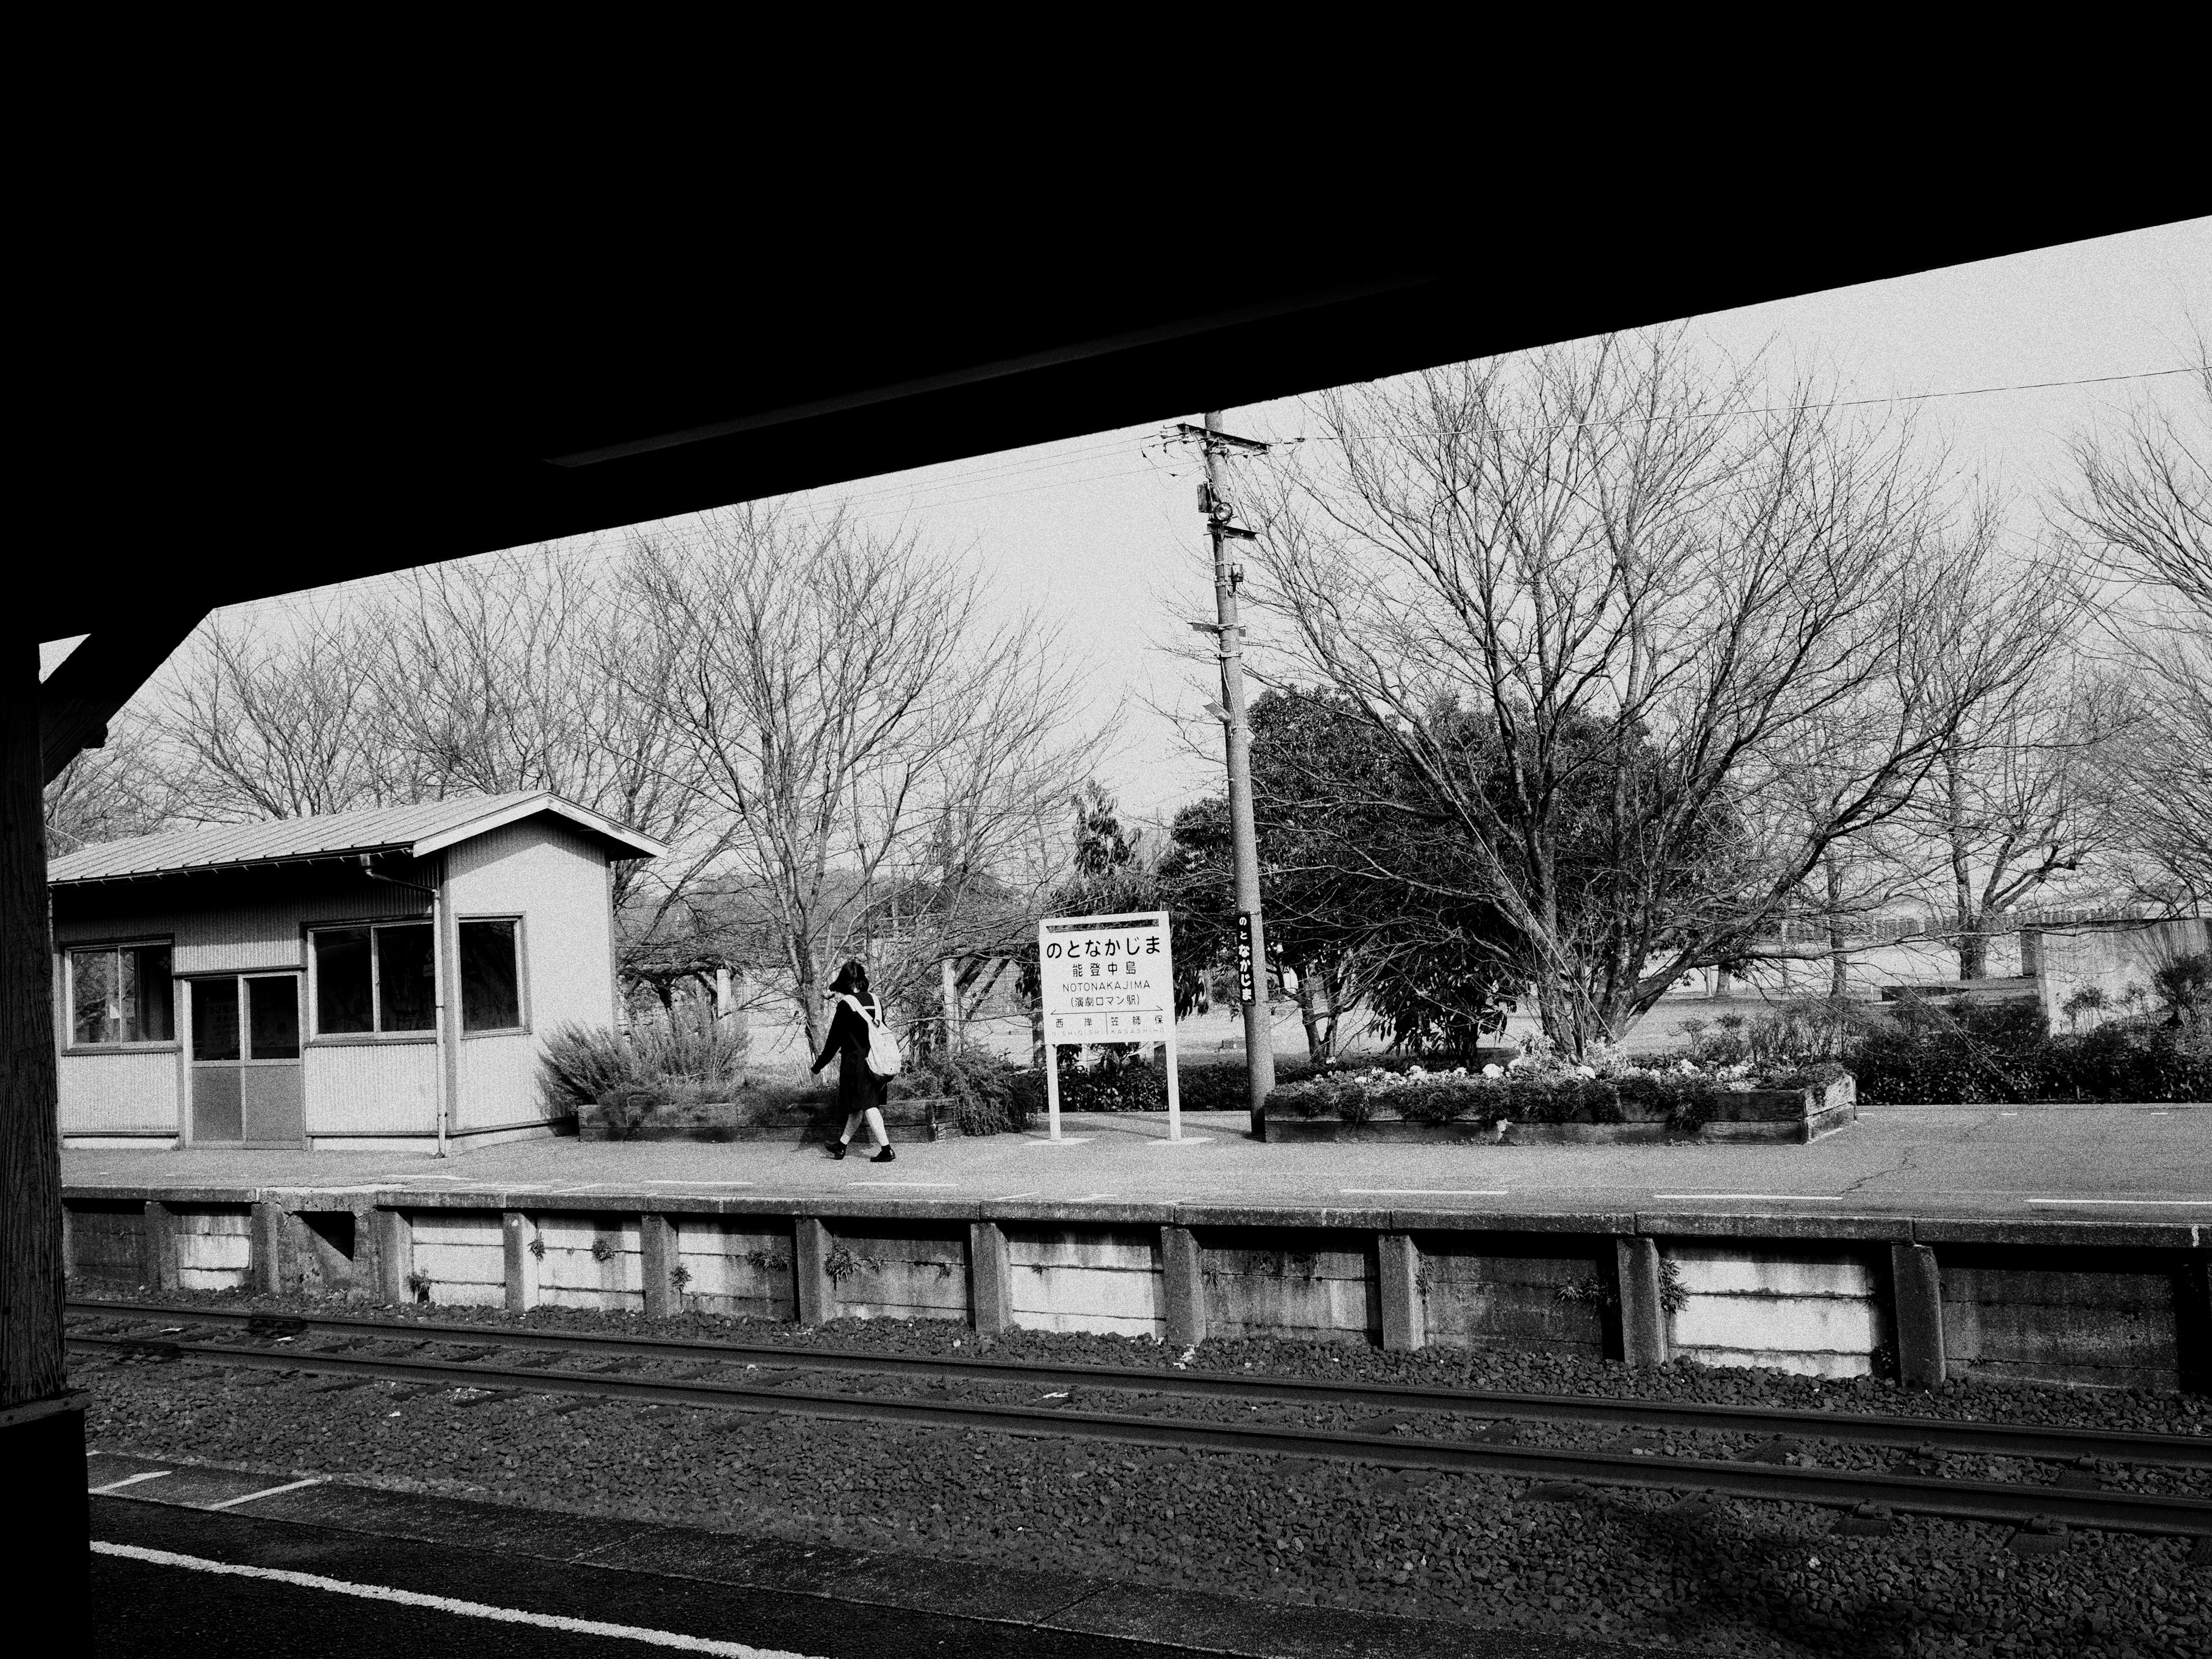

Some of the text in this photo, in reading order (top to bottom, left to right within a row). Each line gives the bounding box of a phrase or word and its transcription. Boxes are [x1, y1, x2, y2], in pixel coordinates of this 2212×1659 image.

[1047, 936, 1160, 959] のとなかじま
[1238, 916, 1252, 1001] のとなかじま
[1073, 961, 1136, 977] 能登中島
[1063, 980, 1150, 992] NOTONAKAJIMA
[1056, 1017, 1092, 1028] 西岸
[1111, 1015, 1163, 1026] 笠師保
